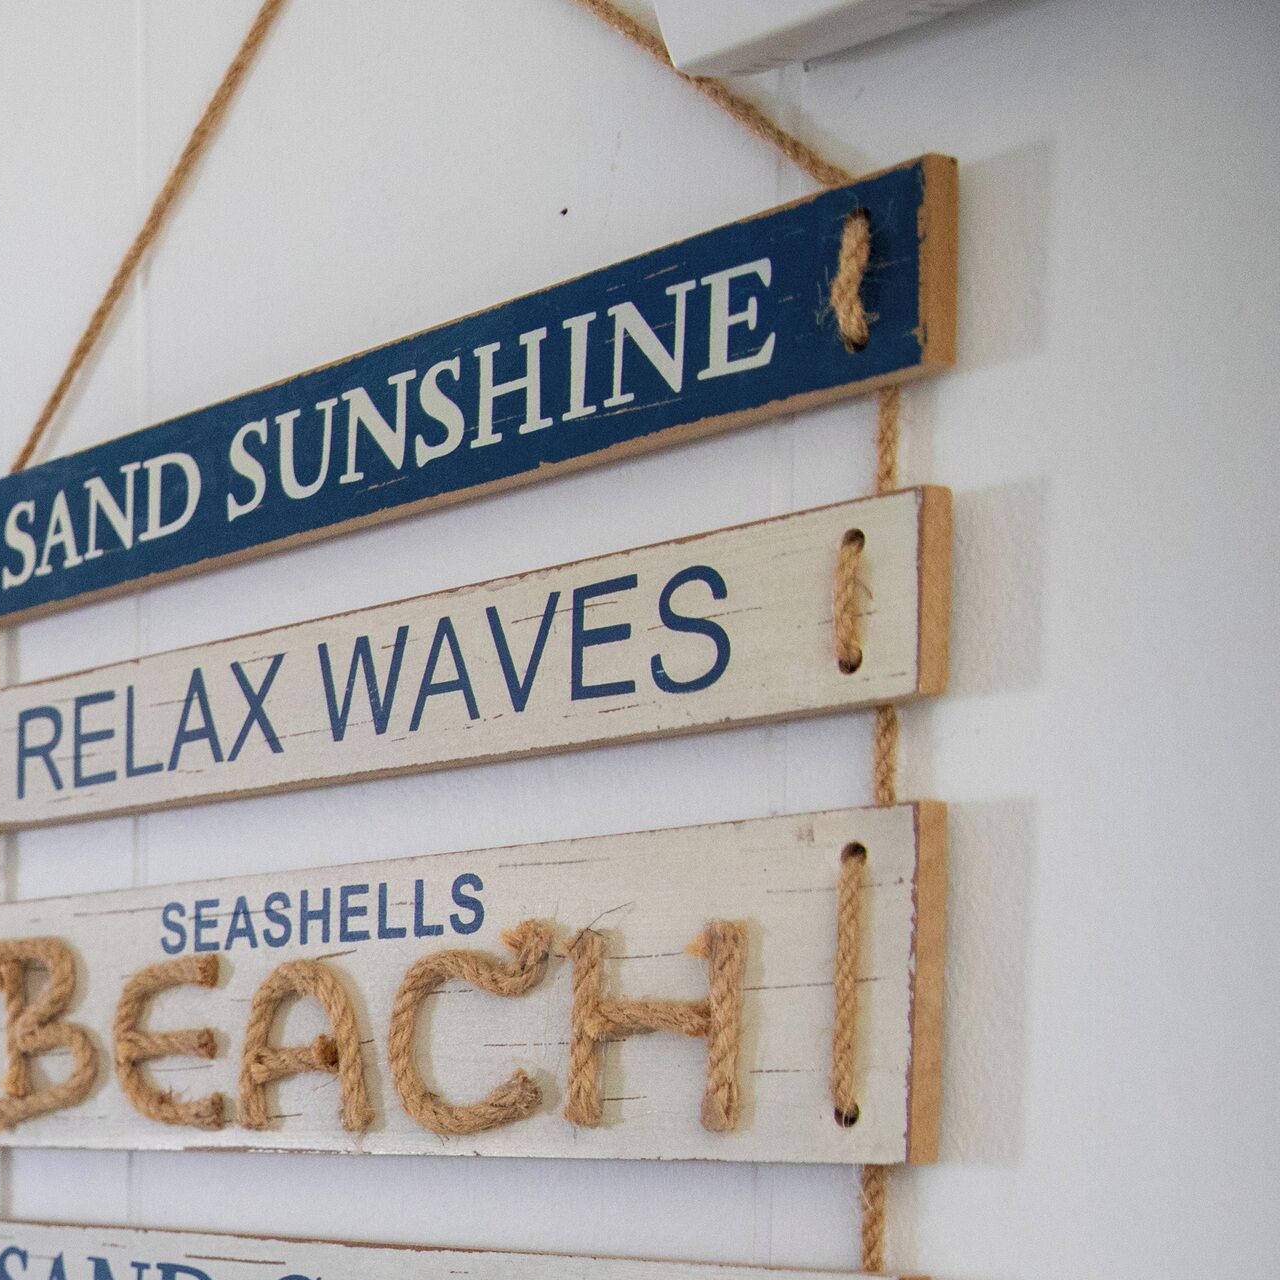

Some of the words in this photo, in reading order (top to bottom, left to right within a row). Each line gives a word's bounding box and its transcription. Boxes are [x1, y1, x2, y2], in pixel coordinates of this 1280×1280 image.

[1, 452, 201, 588] SAND
[227, 258, 775, 521] SUNSHINE
[15, 653, 283, 800] RELAX
[318, 565, 731, 742] WAVES
[160, 873, 486, 954] SEASHELLS
